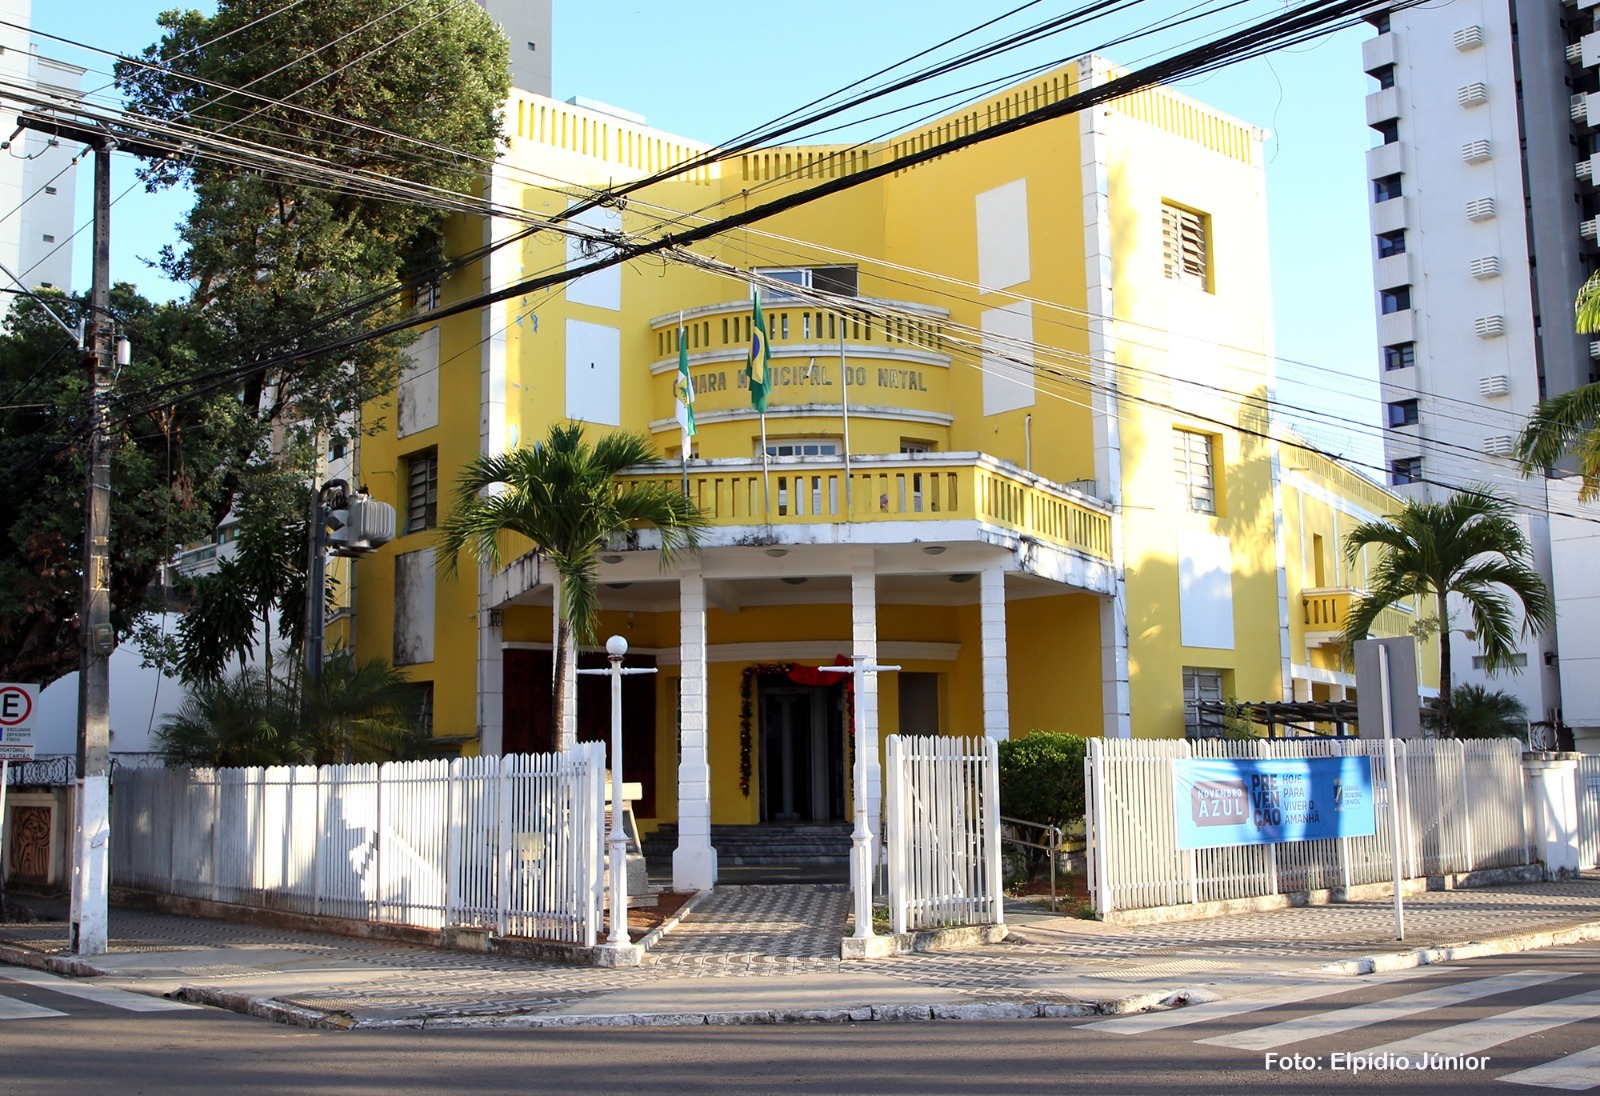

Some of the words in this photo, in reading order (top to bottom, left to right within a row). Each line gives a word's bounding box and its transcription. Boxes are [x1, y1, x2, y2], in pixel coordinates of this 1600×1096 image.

[673, 371, 727, 398] CMARA
[845, 366, 867, 386] DO
[878, 367, 928, 392] NATAL
[2, 693, 20, 718] E
[1251, 773, 1279, 792] PRE
[1282, 774, 1302, 785] HOJE
[1197, 788, 1243, 799] NOVEMBRO
[1252, 791, 1280, 808] VEN
[1283, 787, 1305, 798] PARA
[1198, 798, 1243, 818] AZUL
[1284, 801, 1308, 811] VIVER
[1308, 800, 1315, 811] O
[1285, 811, 1320, 825] AMANHÃ
